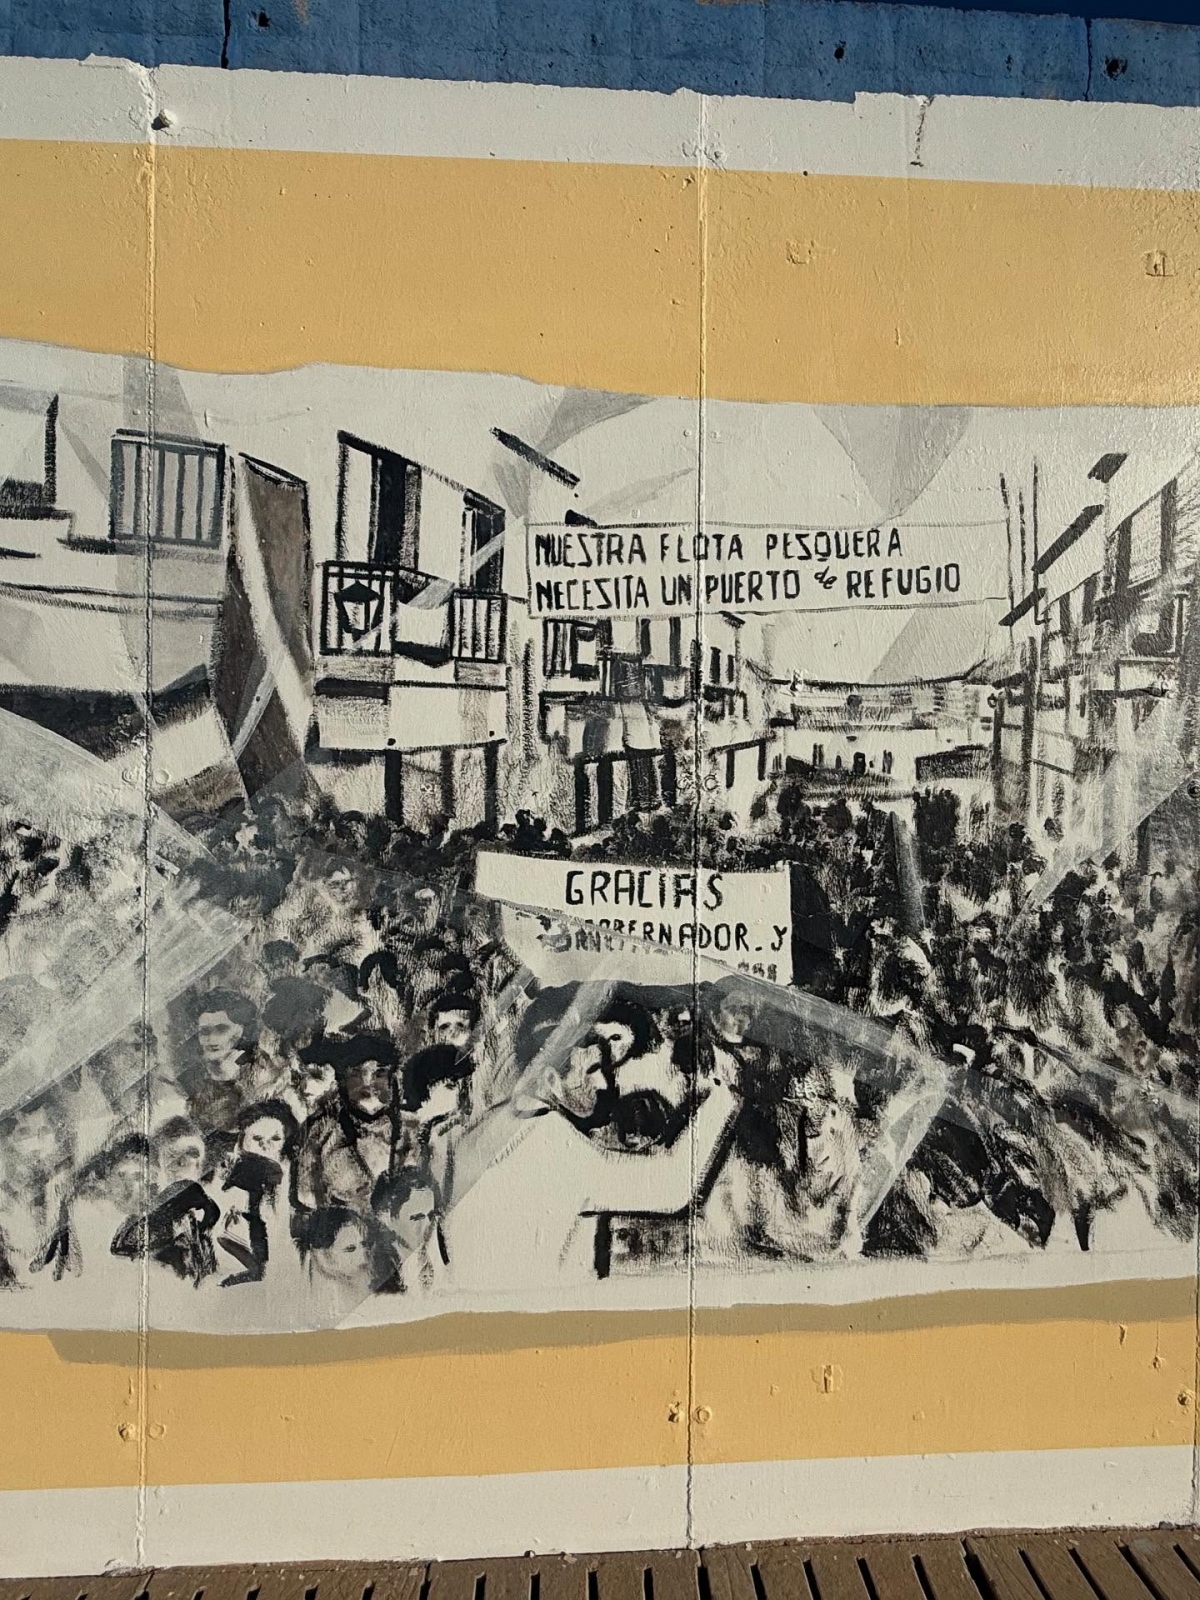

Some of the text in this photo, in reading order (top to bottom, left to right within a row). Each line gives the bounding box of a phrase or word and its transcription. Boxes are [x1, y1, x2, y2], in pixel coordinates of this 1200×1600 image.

[535, 528, 902, 567] NUESTRA FLOTA PESQUERA
[535, 563, 961, 611] NECESITA UN PUERTO de REFUGIO
[565, 869, 724, 911] GRACIAS
